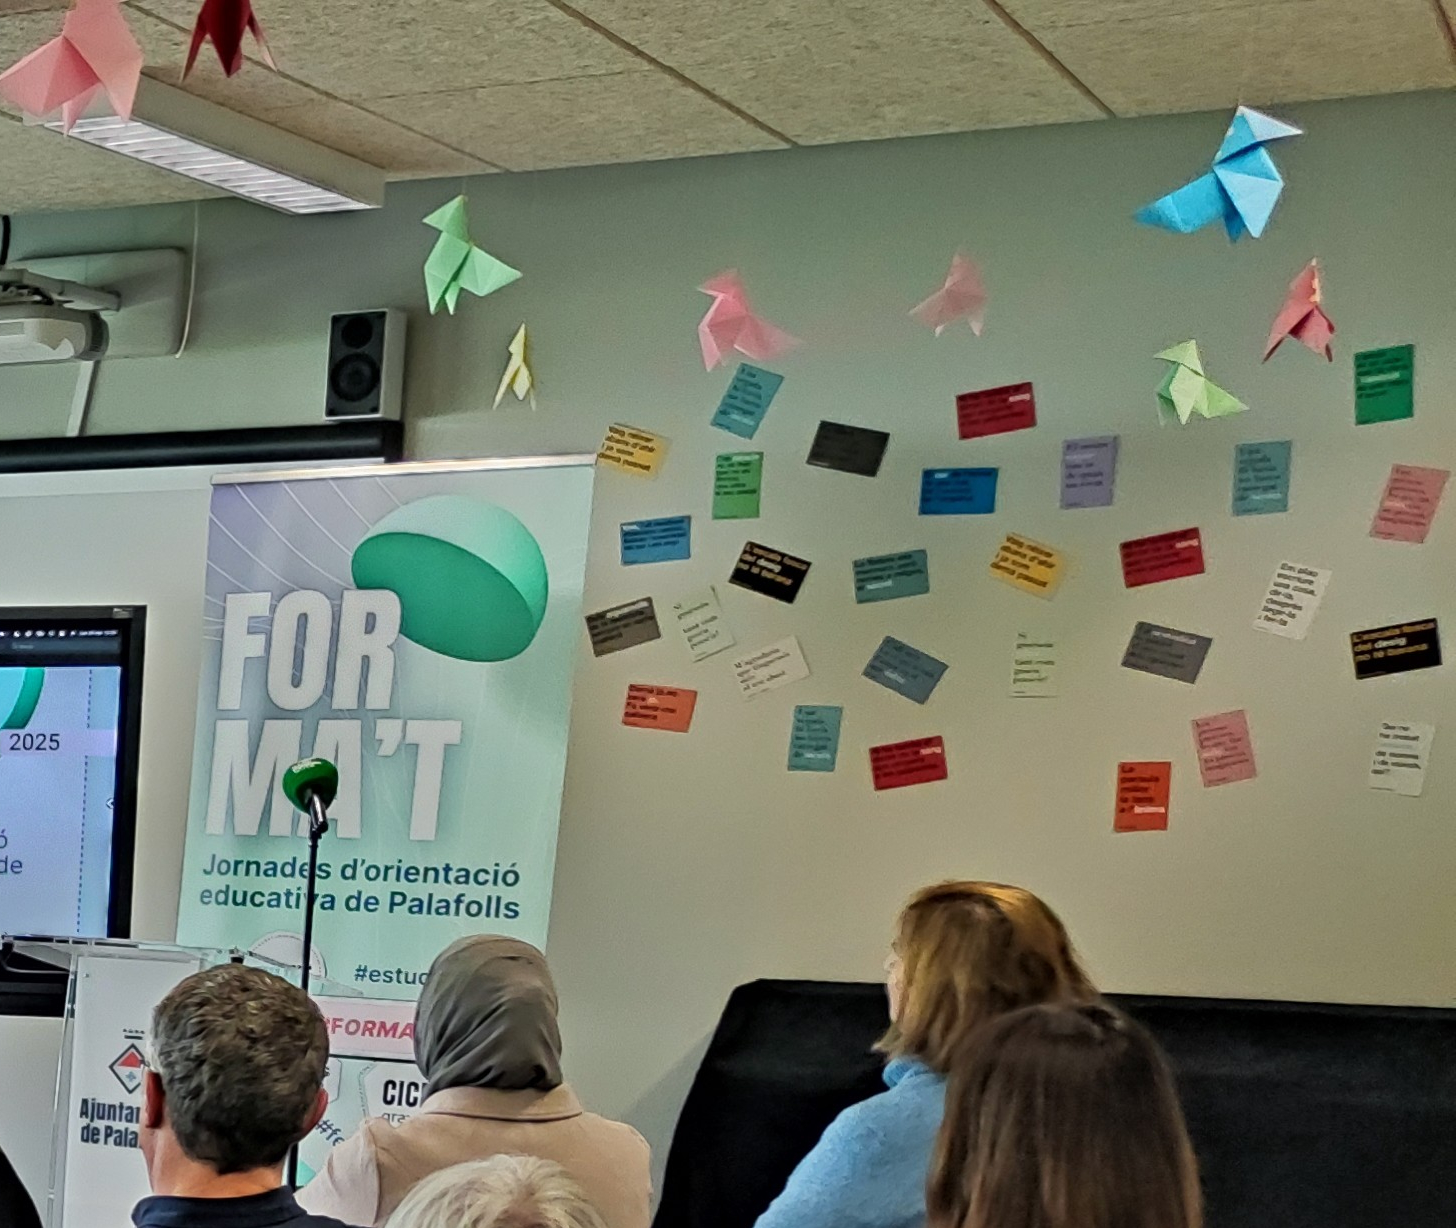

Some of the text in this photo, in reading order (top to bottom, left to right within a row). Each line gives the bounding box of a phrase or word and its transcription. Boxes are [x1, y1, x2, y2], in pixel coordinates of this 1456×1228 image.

[217, 588, 402, 711] FOR
[9, 733, 60, 751] 2025
[205, 719, 462, 841] MA'T
[202, 853, 521, 888] Jornades d'orientació
[344, 889, 380, 913] de
[388, 891, 521, 920] Palafolls
[325, 1017, 416, 1040] FORMA
[80, 1123, 100, 1144] de
